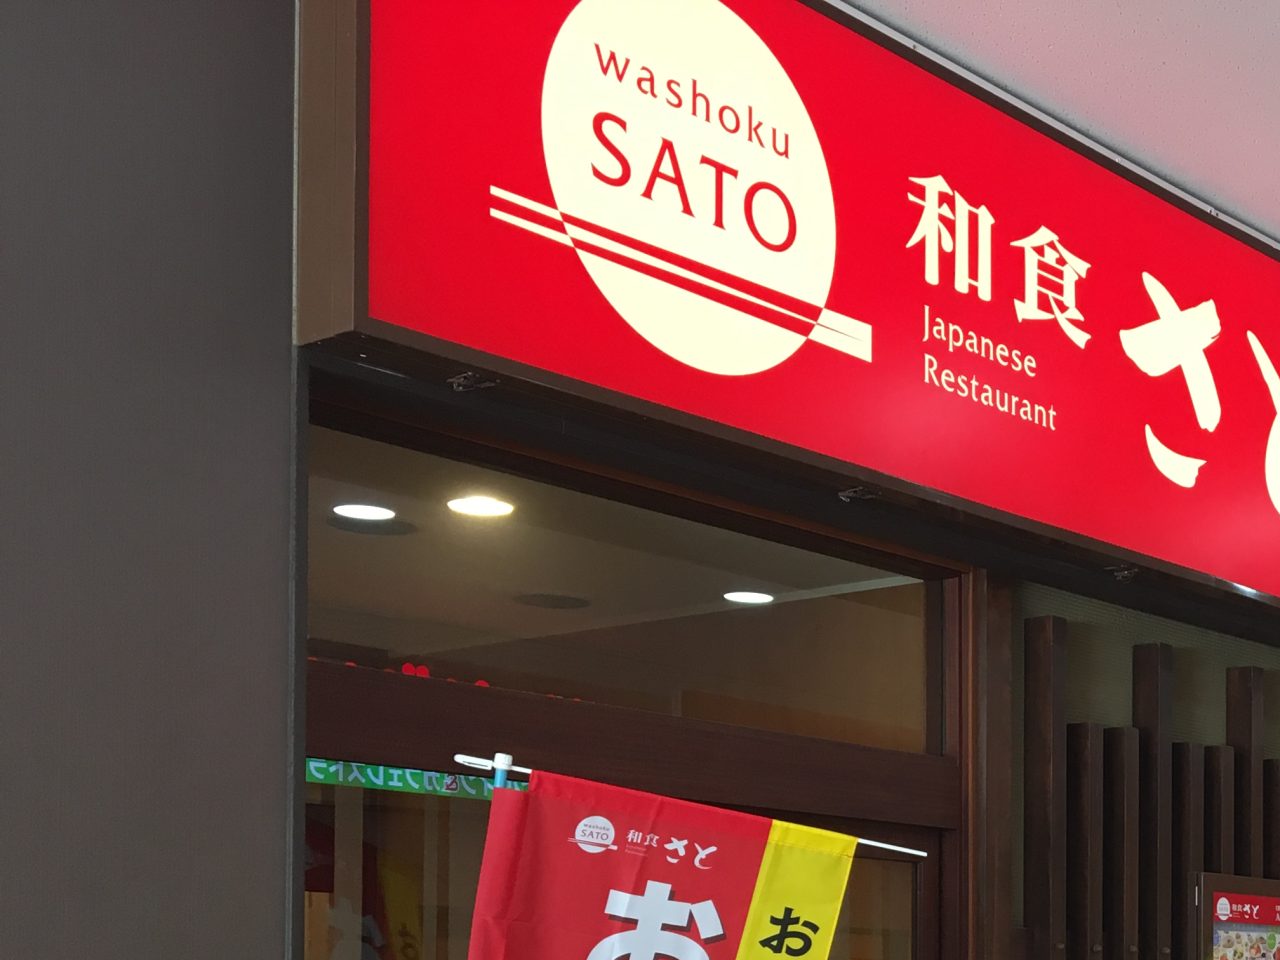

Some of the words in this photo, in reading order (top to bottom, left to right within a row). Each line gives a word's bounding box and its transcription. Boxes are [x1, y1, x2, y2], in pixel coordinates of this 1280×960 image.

[593, 41, 792, 160] washoku
[590, 111, 798, 254] SATO
[905, 174, 1092, 350] 和食
[922, 304, 1038, 379] Japanese
[923, 353, 1057, 432] Restaurant
[580, 829, 609, 841] SATO
[626, 829, 660, 847] 和食
[663, 836, 718, 870] さと
